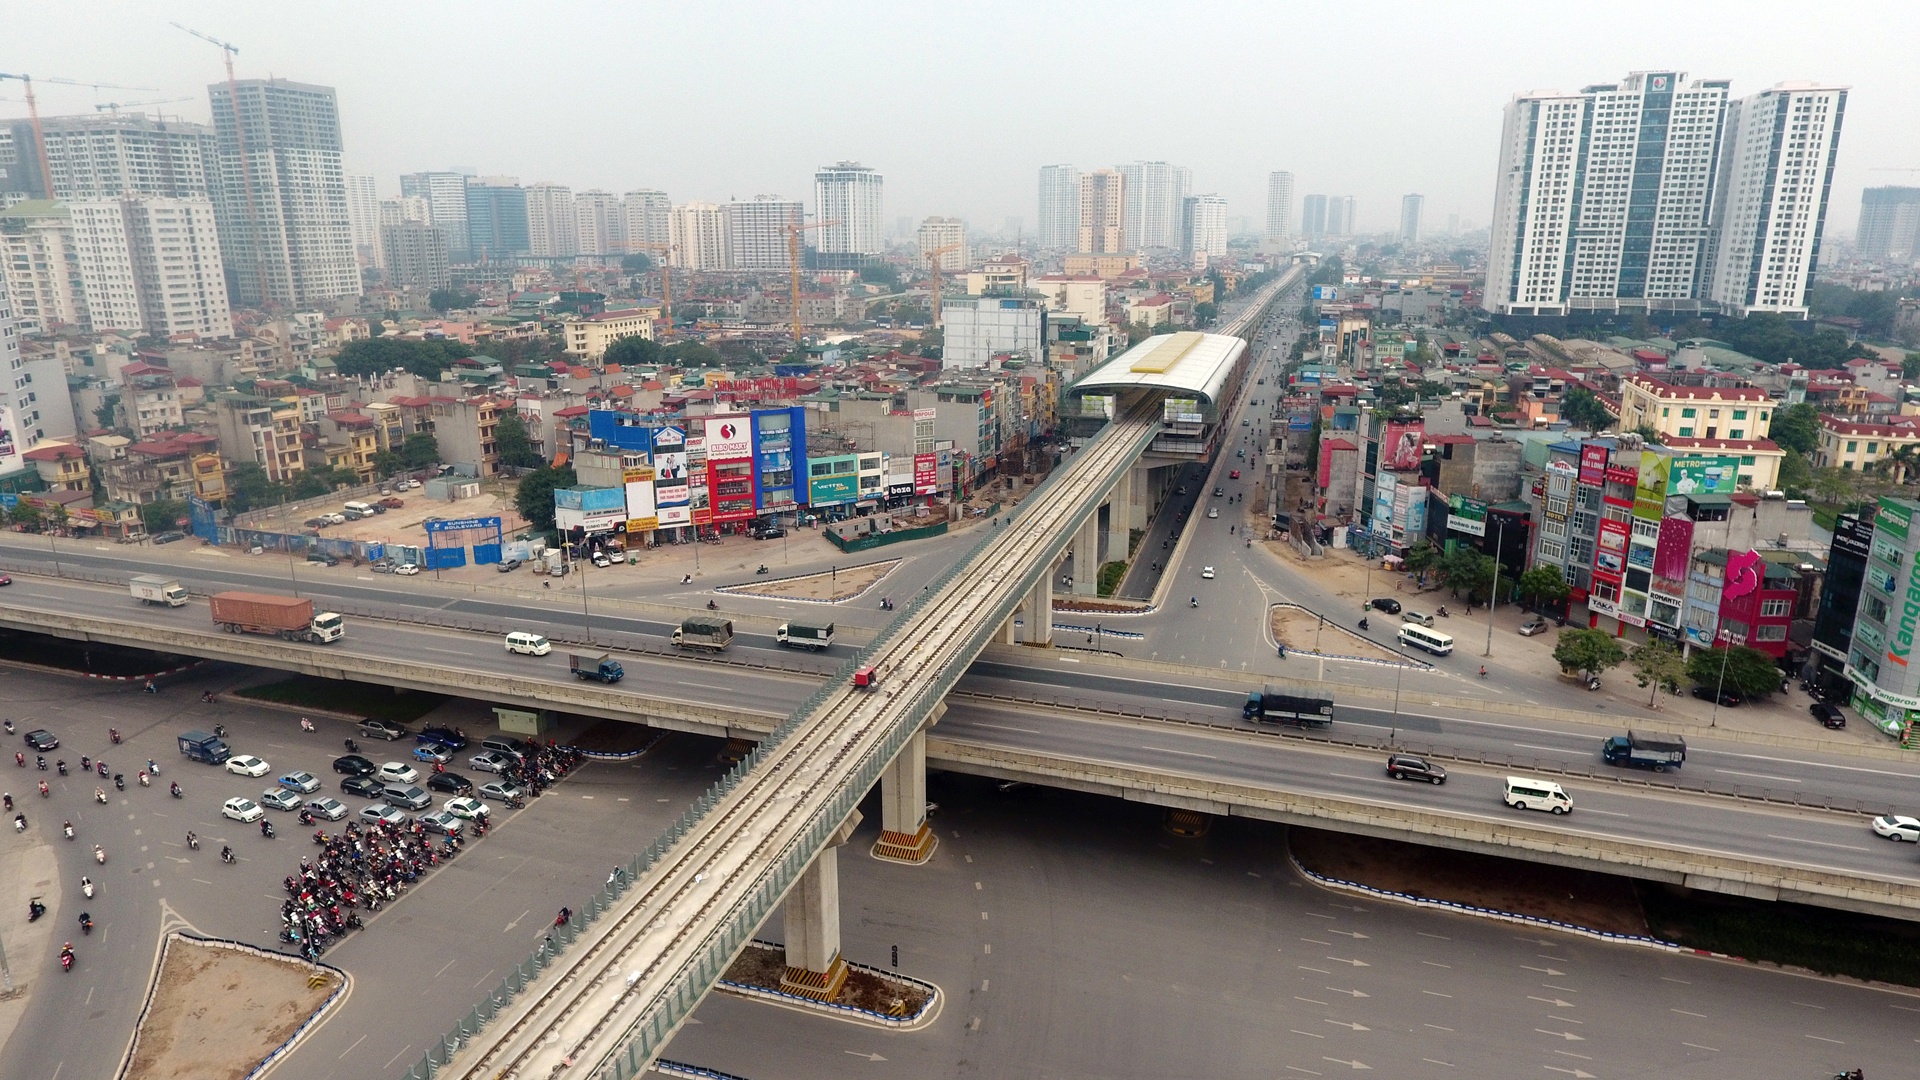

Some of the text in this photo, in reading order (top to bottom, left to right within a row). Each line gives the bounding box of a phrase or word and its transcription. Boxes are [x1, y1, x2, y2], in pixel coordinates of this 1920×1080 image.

[711, 444, 728, 452] BIBO
[729, 442, 748, 450] MART
[1554, 462, 1570, 470] HOTEL
[1546, 511, 1564, 521] HOTEL
[1877, 506, 1908, 528] Kangaroo
[1592, 600, 1614, 610] TAKA
[1650, 592, 1681, 606] ROMANTIC
[1618, 613, 1641, 625] RESUTO
[1646, 620, 1676, 634] Romantic
[1874, 688, 1917, 706] Kangaroo
